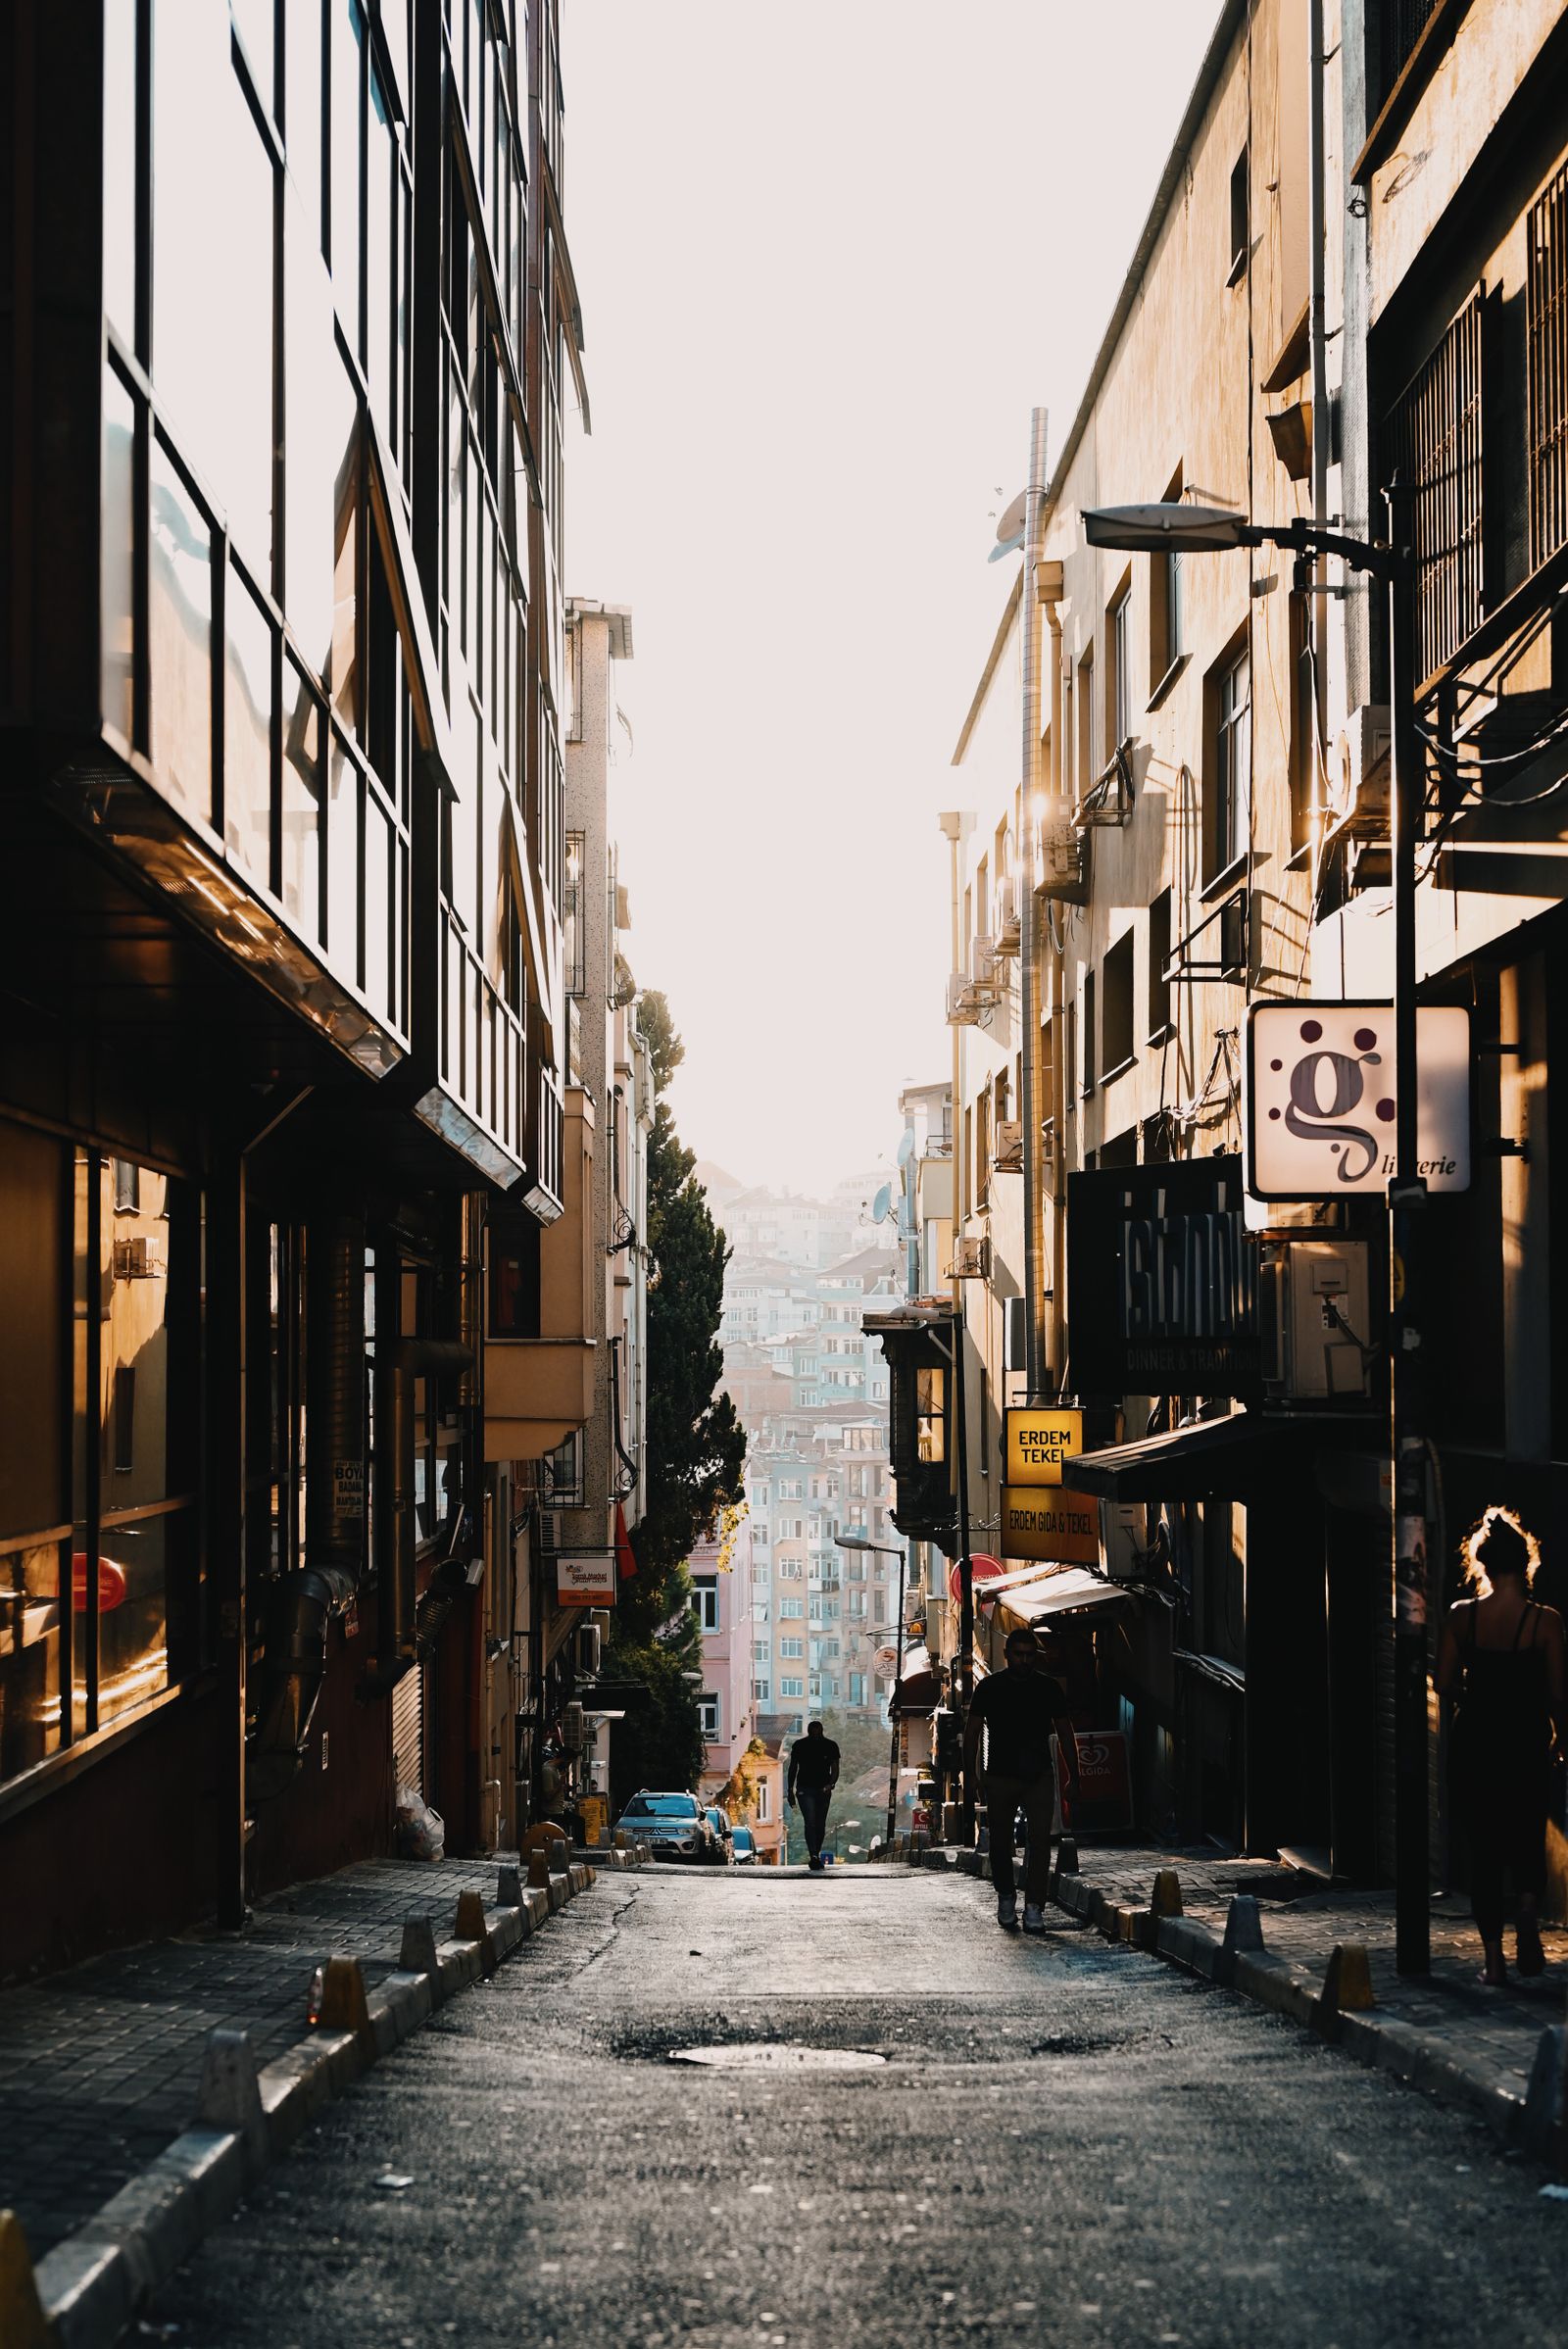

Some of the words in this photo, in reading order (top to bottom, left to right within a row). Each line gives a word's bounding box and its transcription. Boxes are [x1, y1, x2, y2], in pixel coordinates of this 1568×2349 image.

[1285, 1051, 1382, 1184] g
[1382, 1154, 1456, 1175] lierie
[1127, 1348, 1177, 1372] DINNER
[1019, 1431, 1071, 1444] ERDEM
[1009, 1509, 1037, 1531] ERDEM
[1038, 1511, 1056, 1533] GIDA
[1058, 1512, 1065, 1533] &
[1066, 1513, 1093, 1535] TEKEL
[1080, 1767, 1111, 1777] LGIDA
